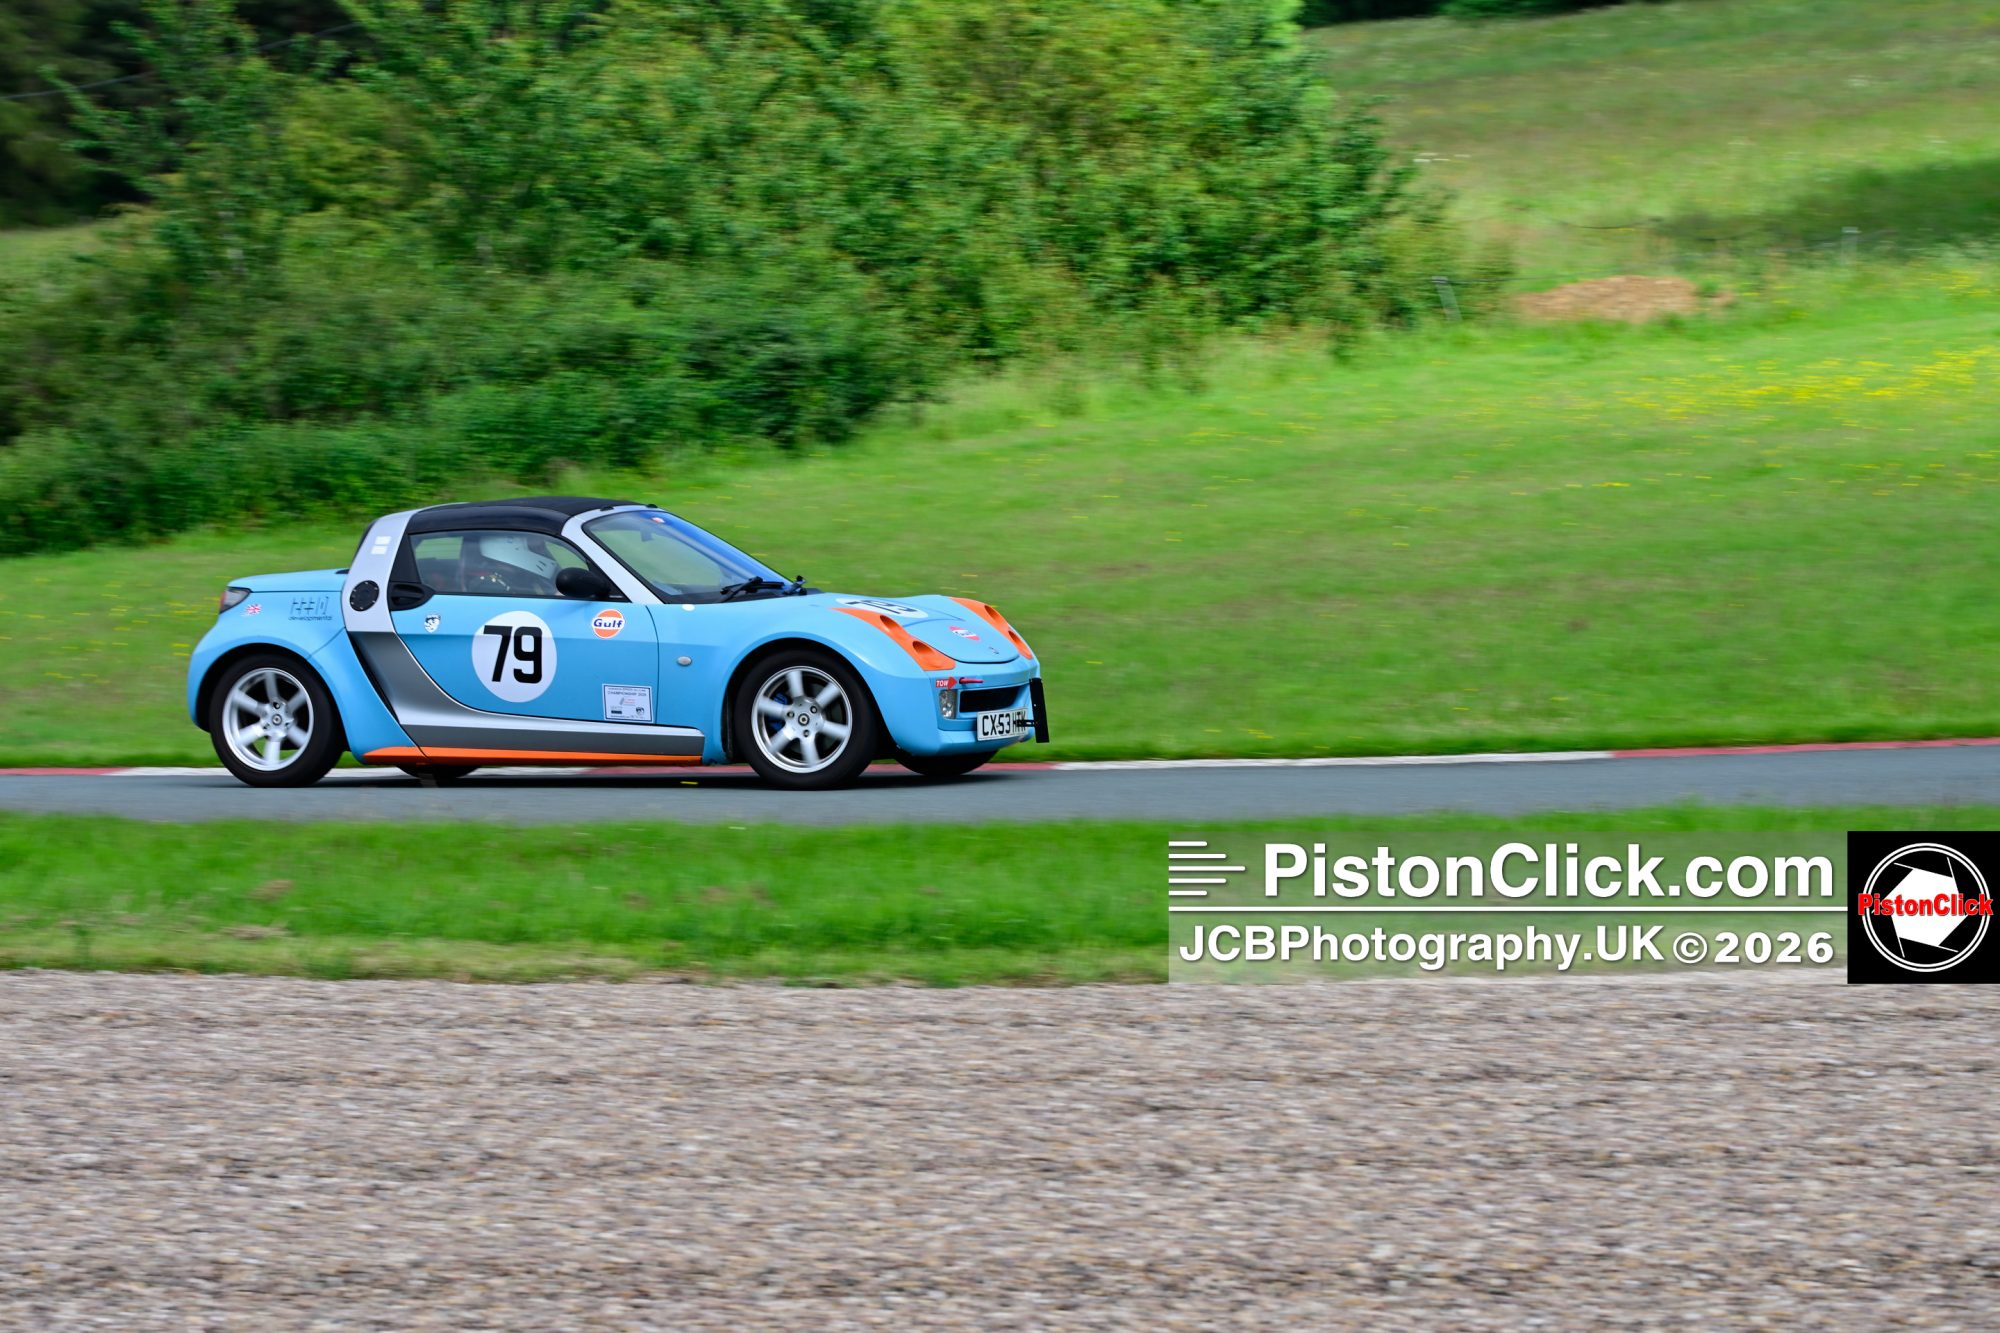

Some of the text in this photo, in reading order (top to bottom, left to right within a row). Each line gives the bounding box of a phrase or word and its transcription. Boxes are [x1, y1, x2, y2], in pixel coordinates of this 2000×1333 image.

[593, 618, 623, 628] Gulf
[483, 625, 542, 684] 79
[936, 680, 949, 688] TOW
[982, 713, 1011, 736] CX53
